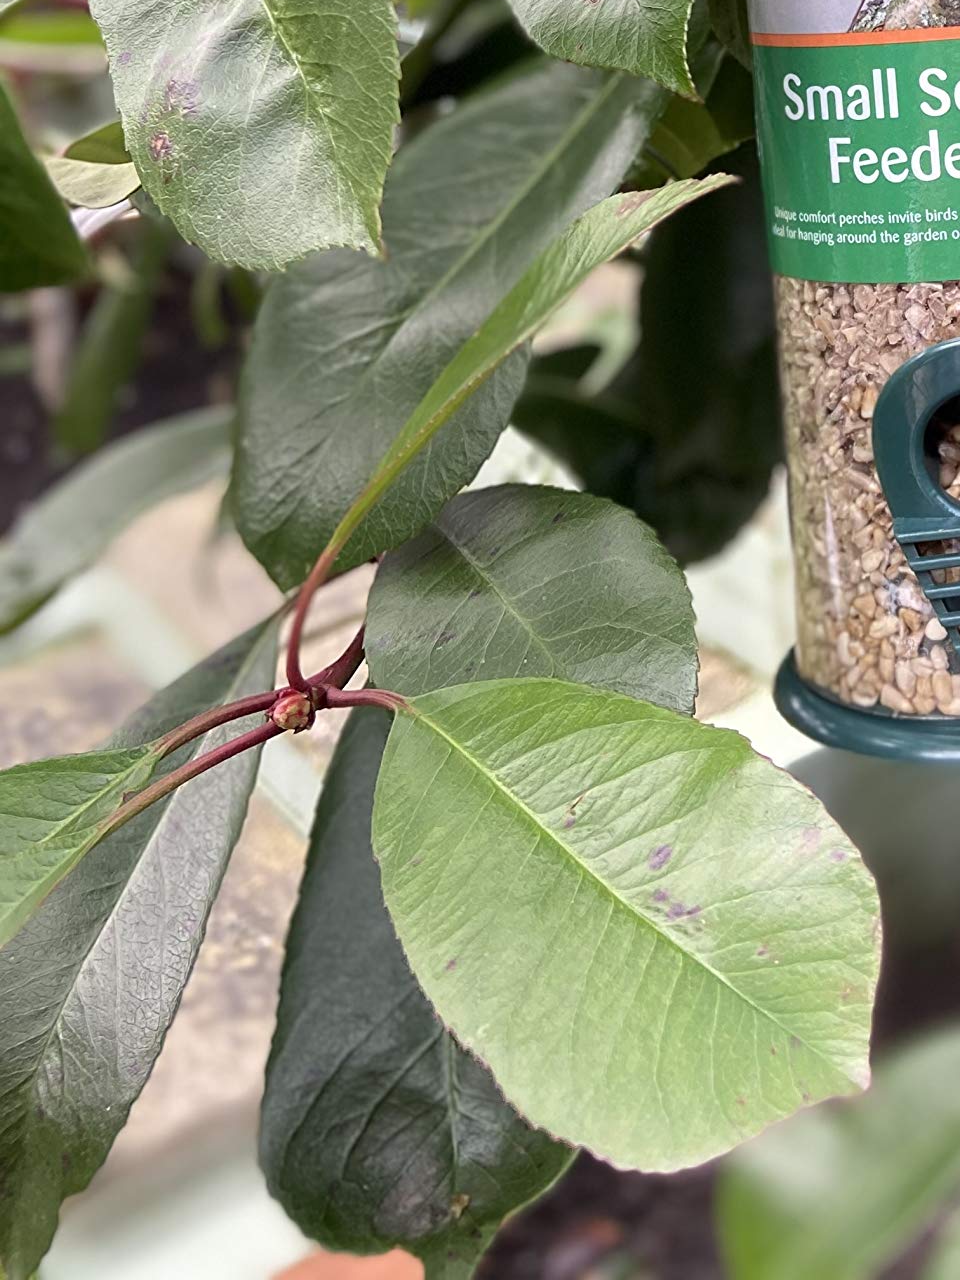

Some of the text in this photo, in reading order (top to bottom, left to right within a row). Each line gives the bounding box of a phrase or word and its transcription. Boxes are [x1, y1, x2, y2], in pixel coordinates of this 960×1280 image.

[783, 67, 899, 121] Small
[798, 210, 837, 225] comfort
[839, 211, 885, 227] perches
[888, 210, 922, 224] invite
[925, 207, 959, 222] birds
[786, 225, 796, 239] for
[797, 227, 835, 246] hanging
[836, 229, 877, 244] around
[880, 228, 900, 243] the
[903, 227, 947, 246] garden
